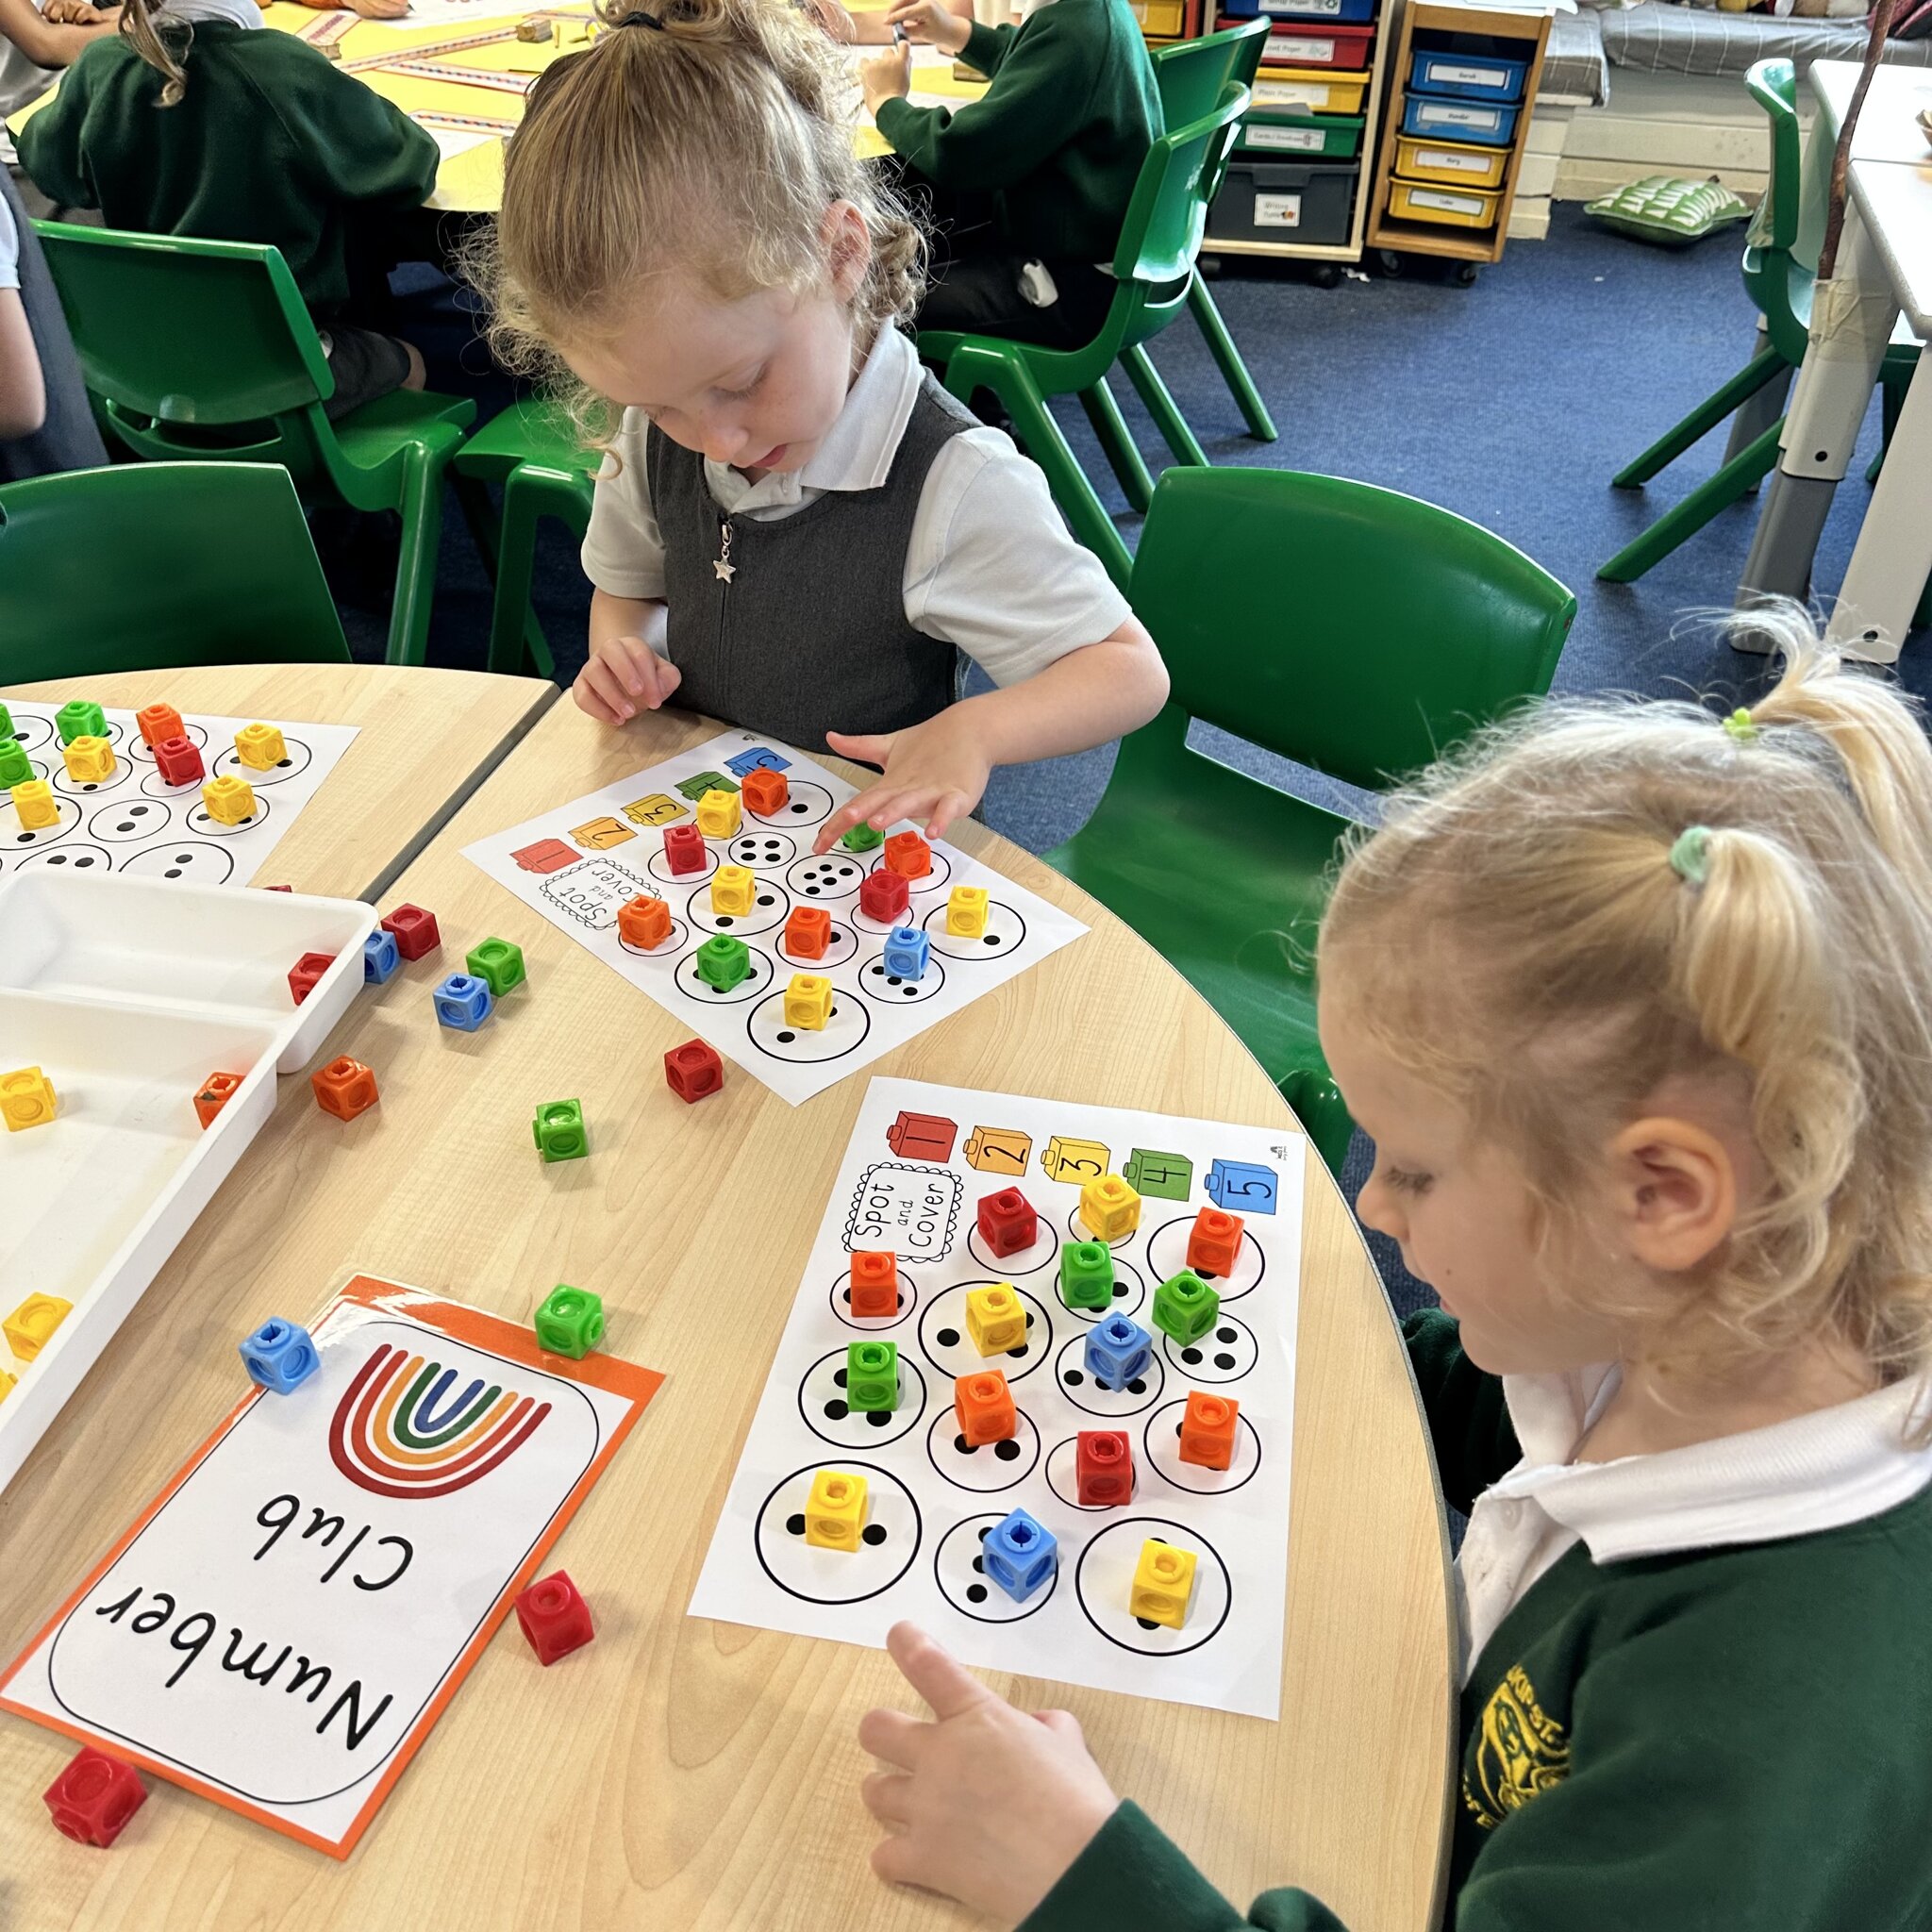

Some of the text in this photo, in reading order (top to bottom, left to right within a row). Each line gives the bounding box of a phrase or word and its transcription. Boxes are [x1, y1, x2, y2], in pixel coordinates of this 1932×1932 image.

[591, 823, 627, 841] 2
[644, 804, 677, 821] 3
[559, 887, 608, 922] Spot
[590, 885, 613, 901] and
[983, 1145, 1026, 1164] 2
[1058, 1157, 1102, 1177] 3
[1142, 1166, 1187, 1185] 4
[1227, 1179, 1272, 1199] 5
[854, 1183, 895, 1238] Spot
[897, 1200, 914, 1226] and
[908, 1183, 944, 1247] Cover
[253, 1493, 414, 1591] Club
[95, 1586, 394, 1751] Number
